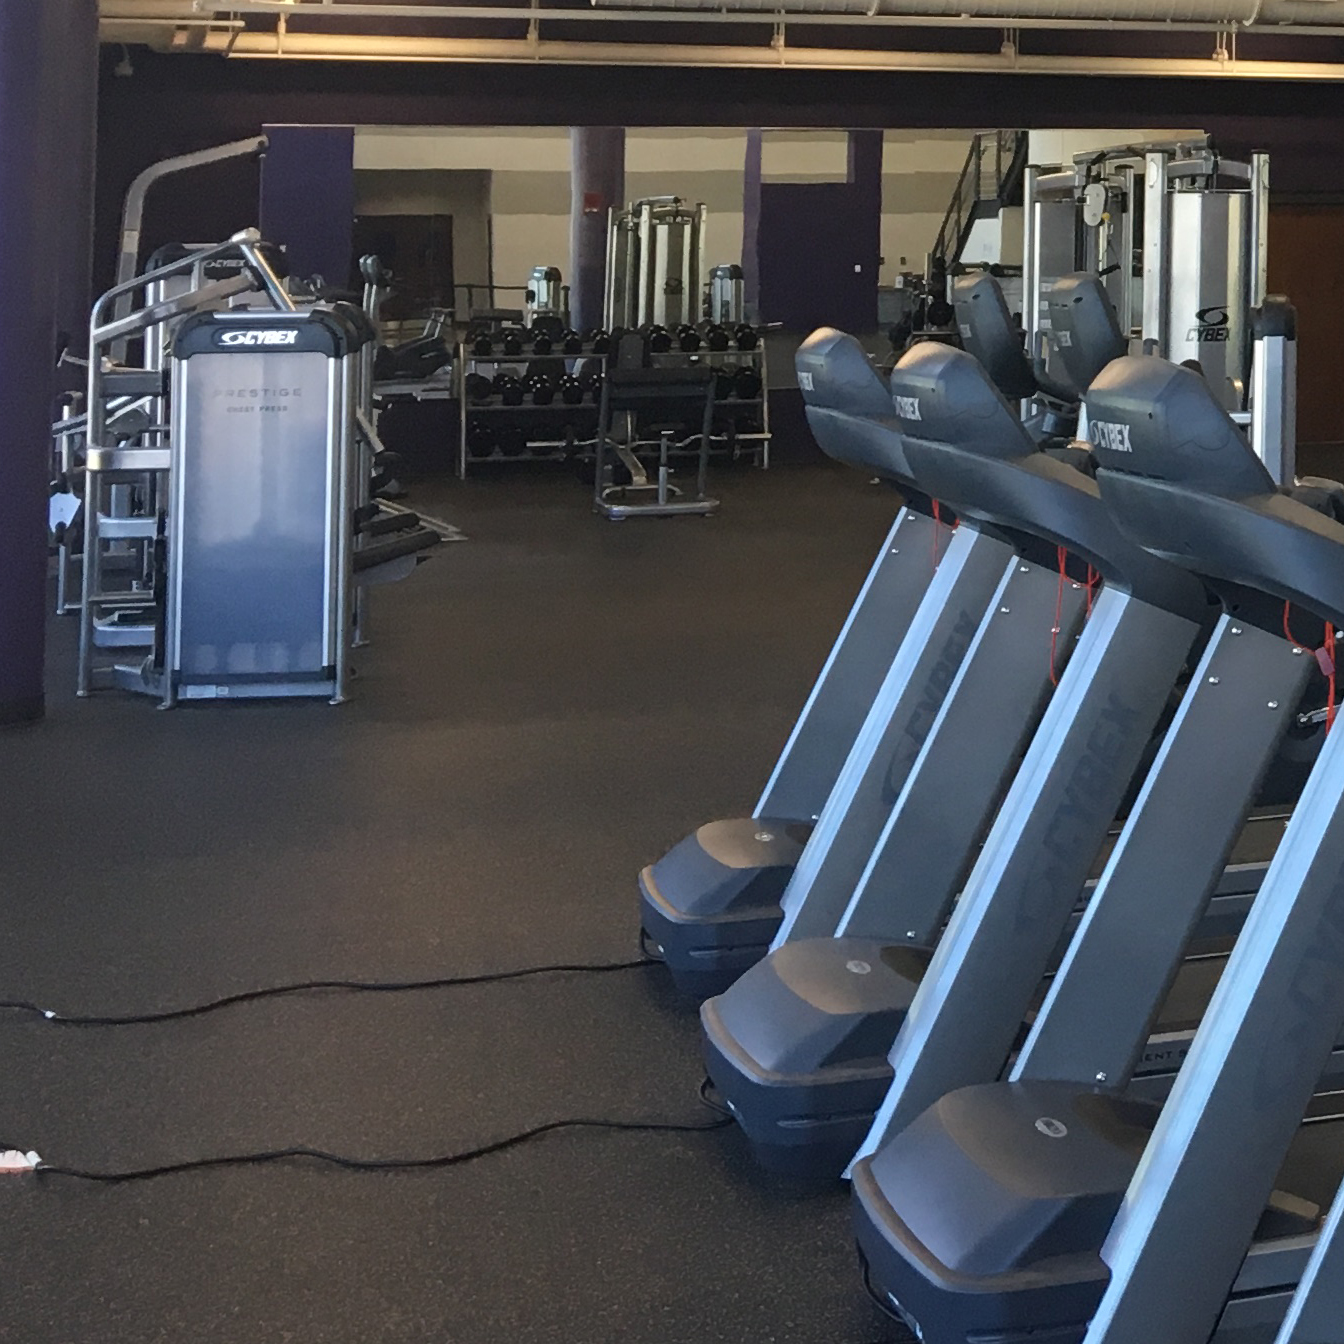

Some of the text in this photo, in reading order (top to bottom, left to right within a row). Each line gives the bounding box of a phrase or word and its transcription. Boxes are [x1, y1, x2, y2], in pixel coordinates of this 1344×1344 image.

[244, 330, 299, 345] CYBEX
[1186, 327, 1232, 343] CYBEX
[213, 387, 303, 398] PRESTIGE
[259, 405, 288, 413] PRESS
[1097, 422, 1133, 453] CYBEX
